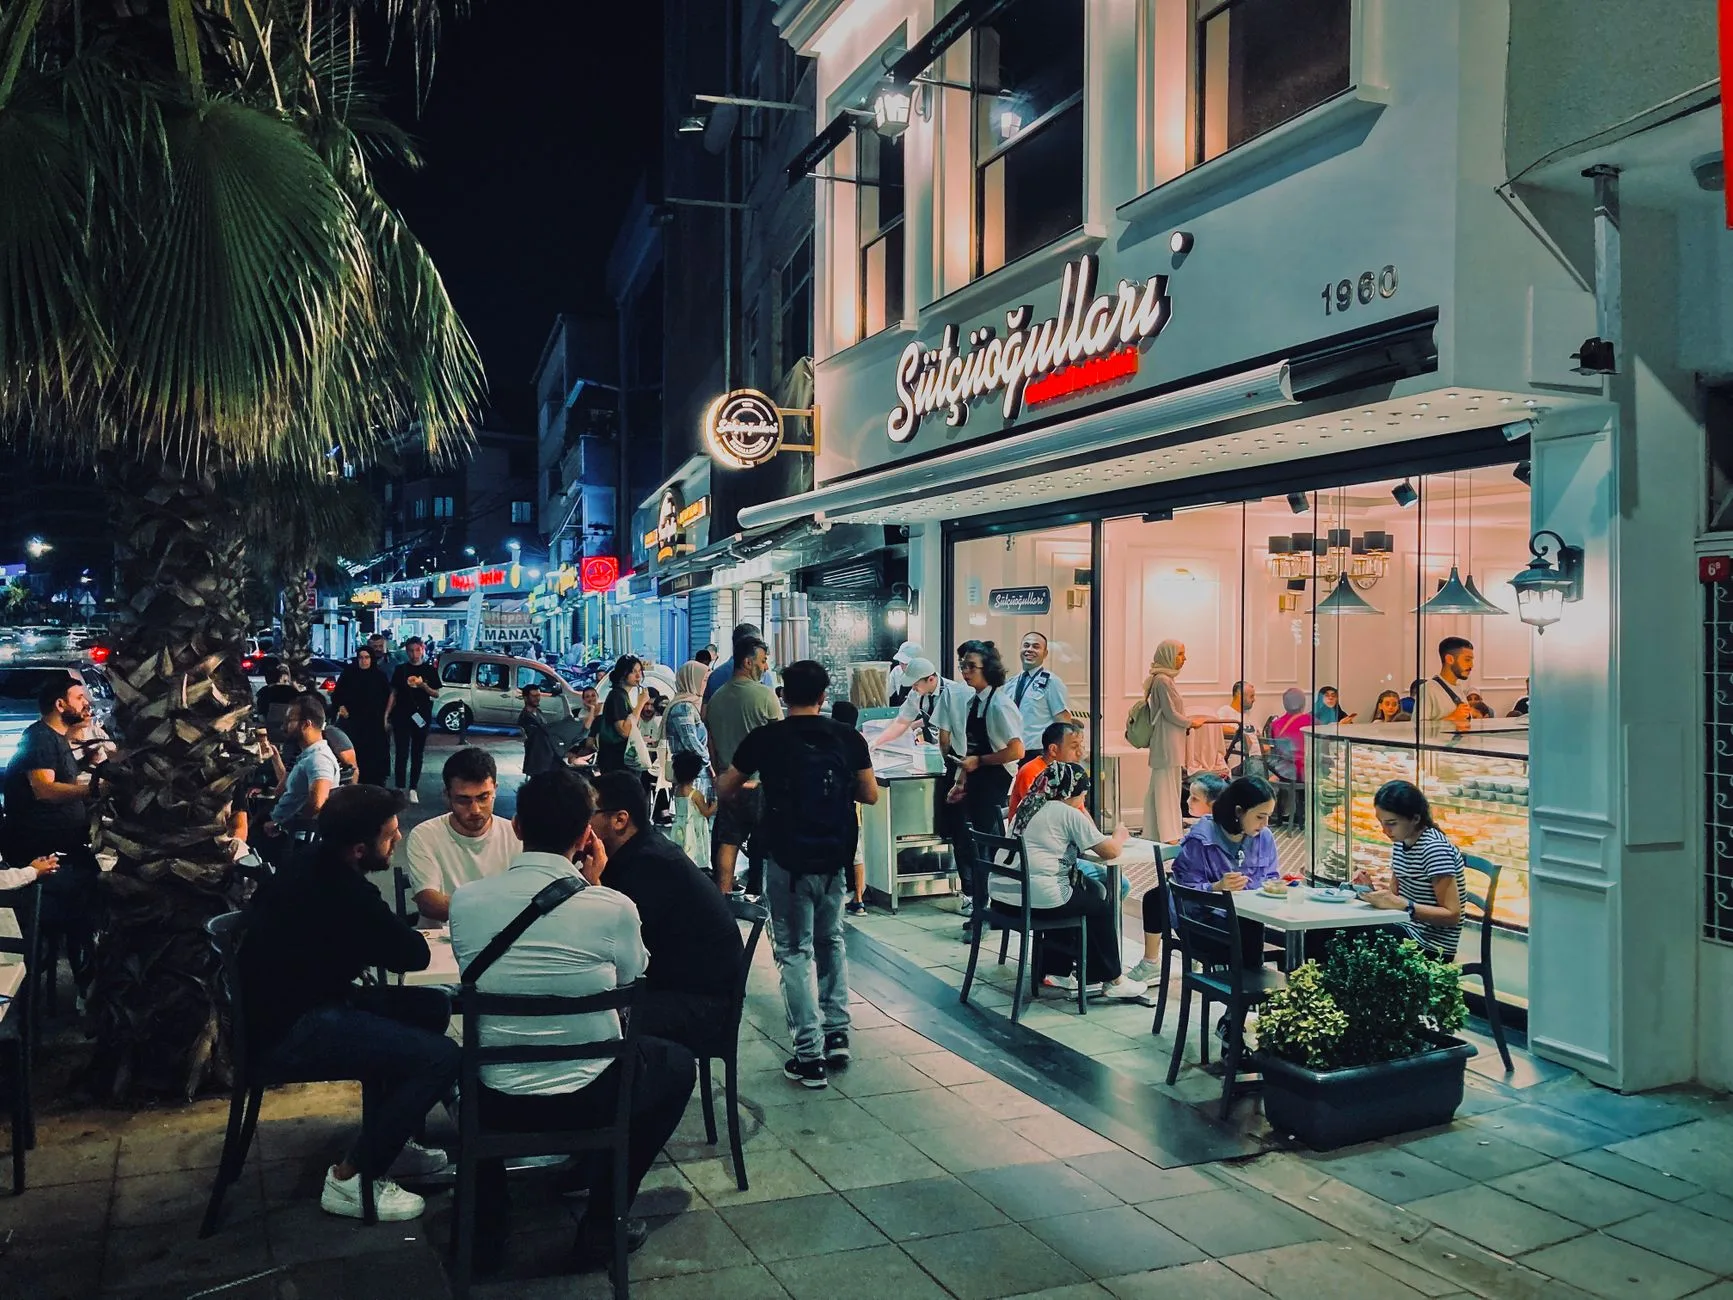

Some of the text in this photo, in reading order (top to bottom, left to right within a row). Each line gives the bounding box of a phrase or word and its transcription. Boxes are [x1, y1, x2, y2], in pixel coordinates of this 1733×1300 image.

[1321, 264, 1399, 316] 1960
[887, 253, 1171, 442] Sütçüoğulları
[484, 628, 540, 641] MANAV
